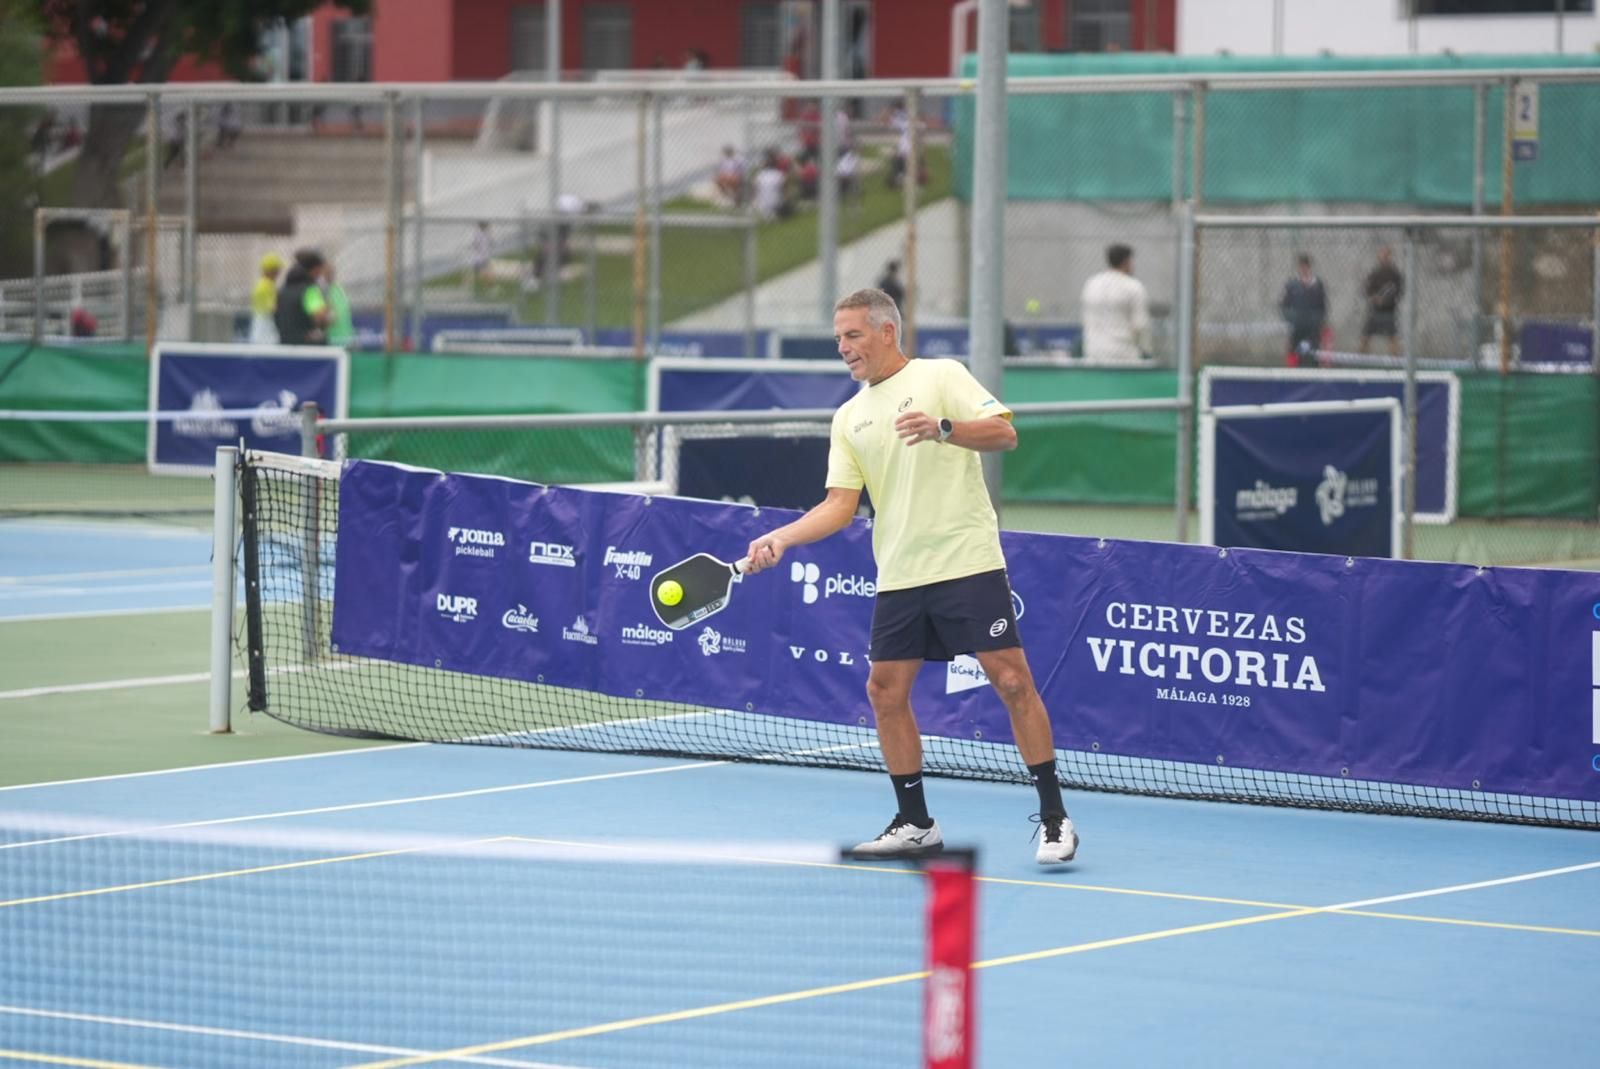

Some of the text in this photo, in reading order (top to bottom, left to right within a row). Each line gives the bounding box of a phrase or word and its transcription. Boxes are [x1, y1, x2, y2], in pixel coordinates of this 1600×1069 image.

[456, 546, 494, 558] pickleball
[615, 565, 641, 580] X-40
[825, 573, 877, 598] pickle
[437, 593, 478, 616] DUPR
[1106, 601, 1306, 643] CERVEZAS
[1086, 637, 1326, 692] VICTORIA
[1156, 687, 1251, 707] MÁLAGA 1928
